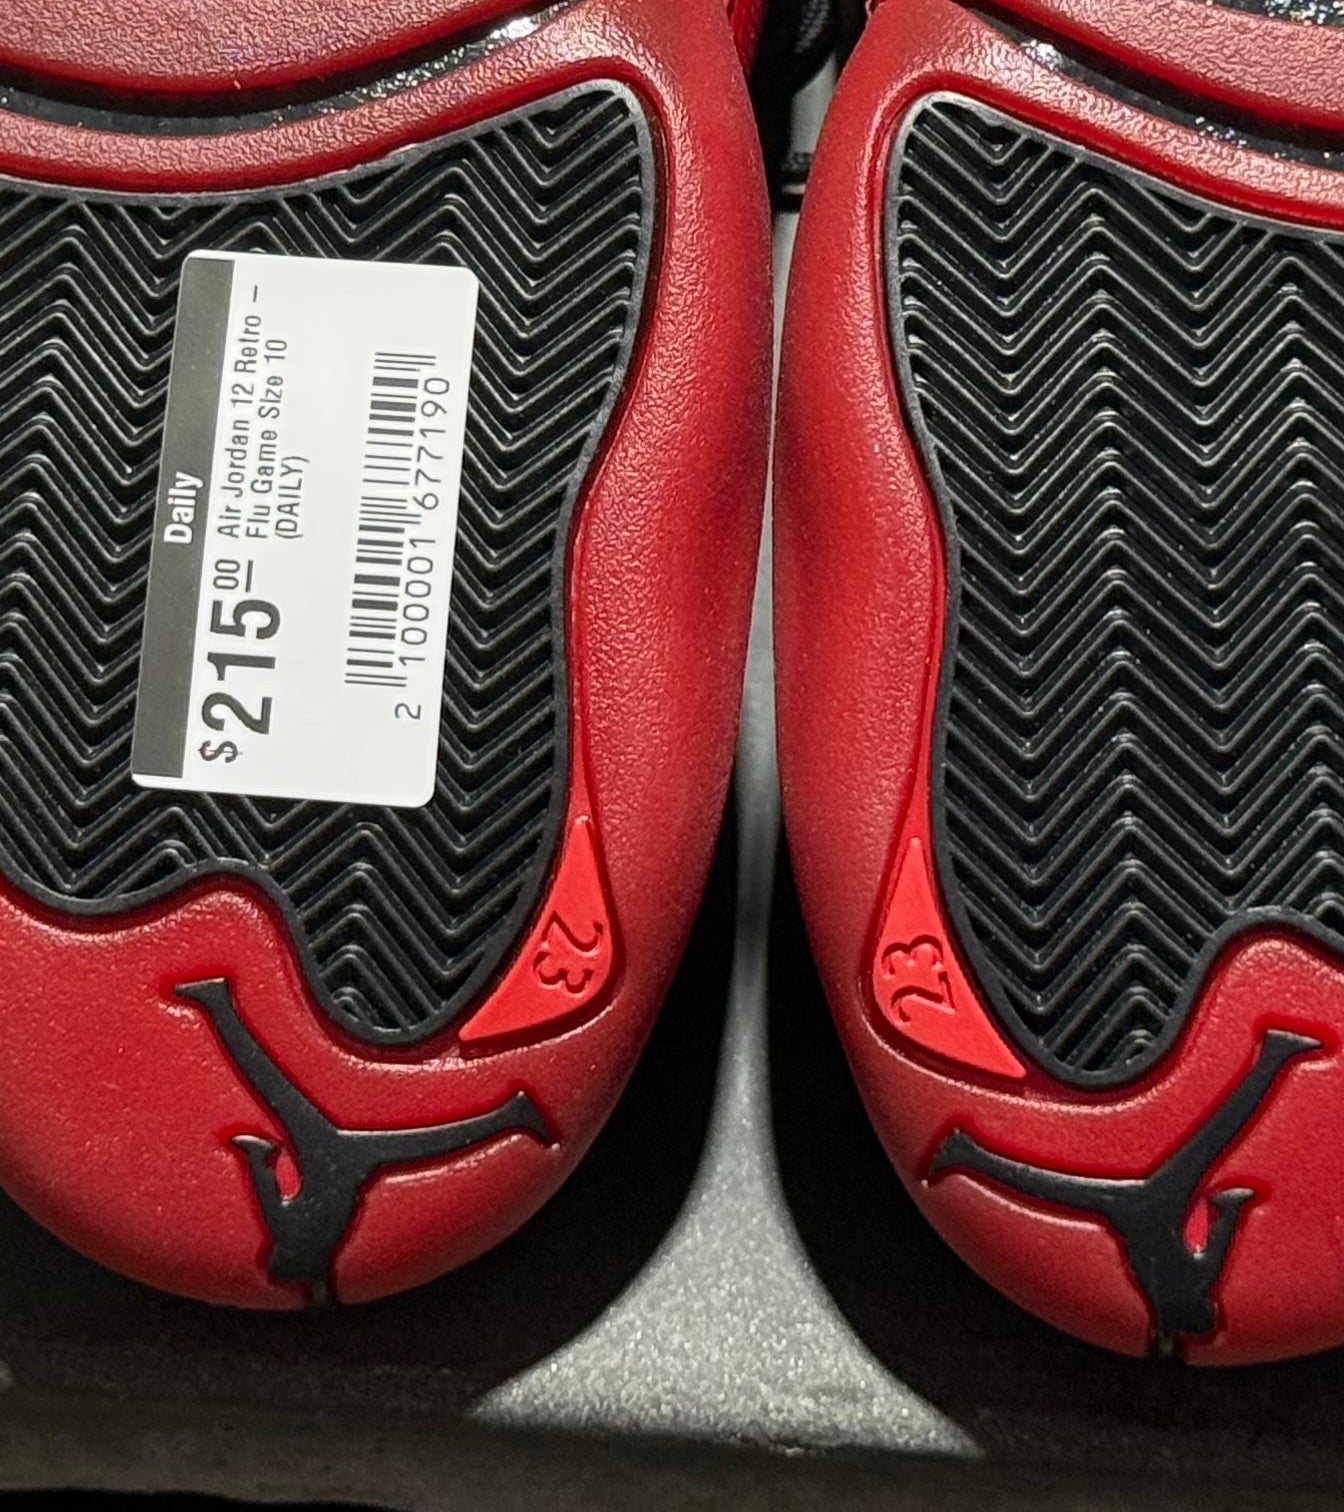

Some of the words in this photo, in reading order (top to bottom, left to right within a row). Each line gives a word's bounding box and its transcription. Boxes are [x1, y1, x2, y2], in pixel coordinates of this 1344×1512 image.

[234, 314, 262, 374] Retro
[264, 339, 288, 361] 10
[230, 383, 255, 405] 12
[258, 375, 284, 420] Size
[221, 419, 250, 498] Jordan
[250, 430, 278, 494] Game
[413, 377, 450, 511] 677190
[164, 471, 203, 544] Daily
[217, 504, 242, 539] Air
[246, 504, 272, 539] Flu
[275, 455, 310, 540] (DAILY)
[398, 537, 436, 667] 100001
[395, 702, 421, 720] 2
[533, 910, 604, 996] 23
[881, 934, 957, 1024] 23
